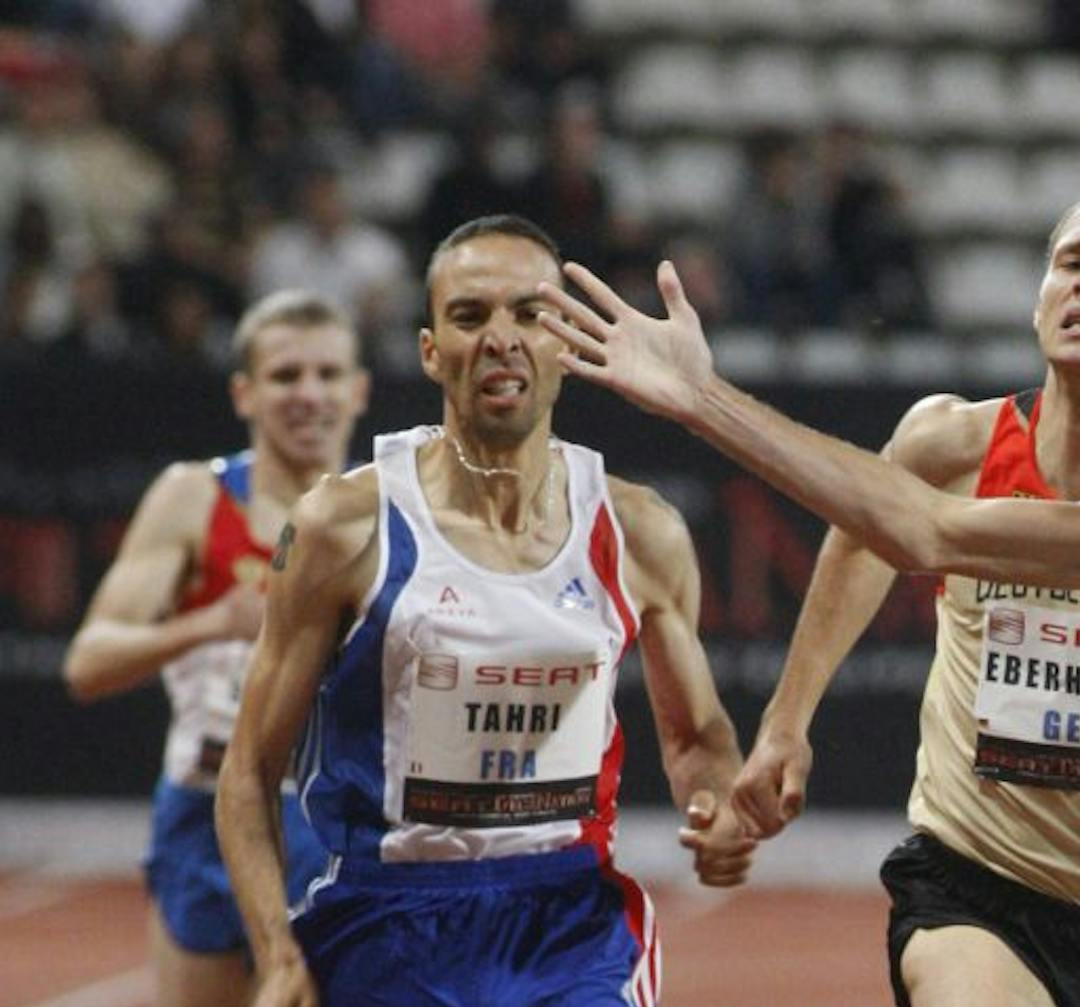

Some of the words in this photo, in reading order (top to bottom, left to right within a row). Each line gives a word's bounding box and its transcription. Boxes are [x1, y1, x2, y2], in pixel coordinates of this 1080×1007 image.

[474, 660, 606, 687] SEAT
[465, 702, 562, 732] TAHRI
[479, 749, 537, 779] FRA
